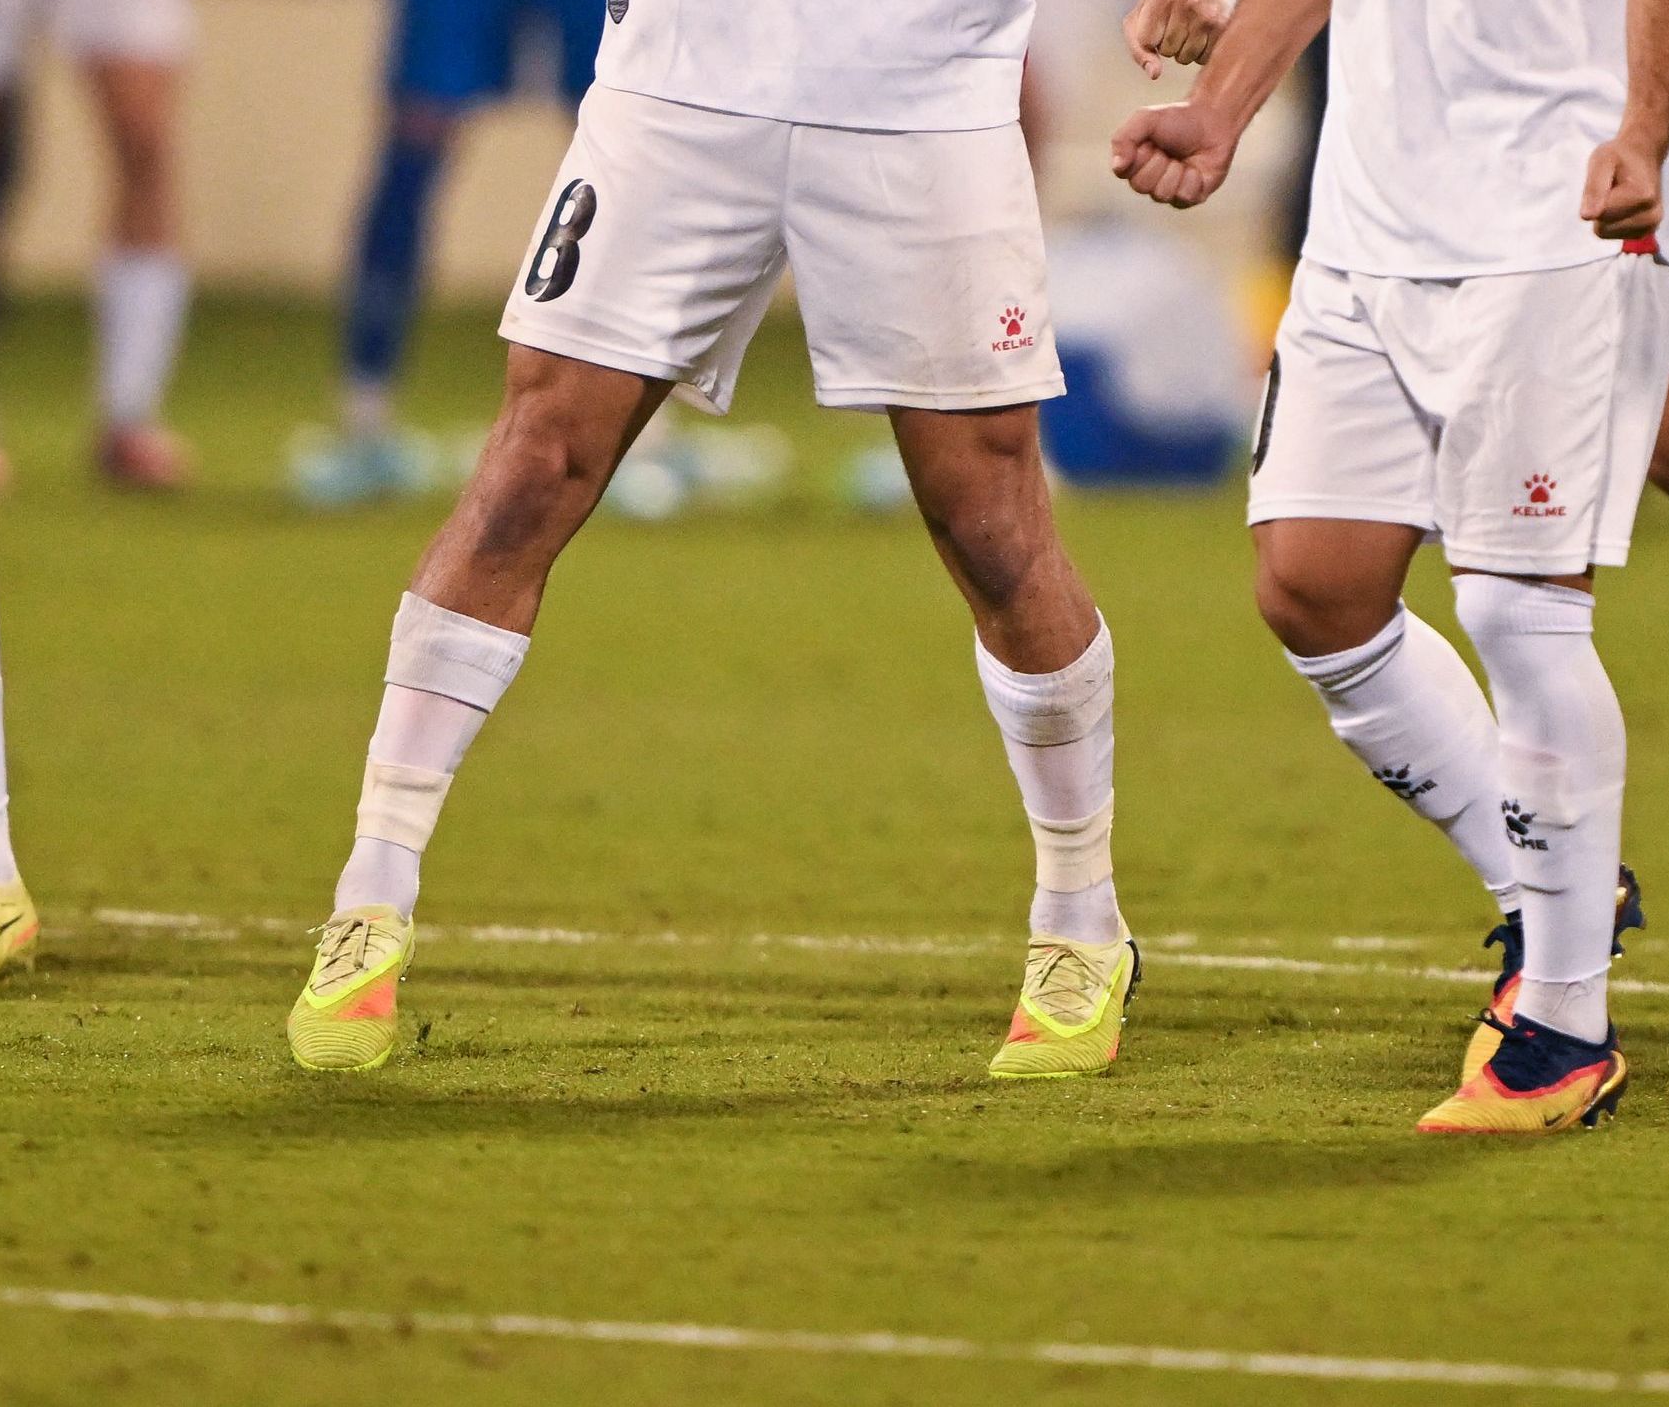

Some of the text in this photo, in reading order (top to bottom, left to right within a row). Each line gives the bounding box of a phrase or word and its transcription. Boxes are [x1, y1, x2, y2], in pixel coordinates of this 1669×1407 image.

[525, 178, 597, 303] 8
[992, 336, 1034, 352] KELME
[1513, 506, 1567, 517] KELME
